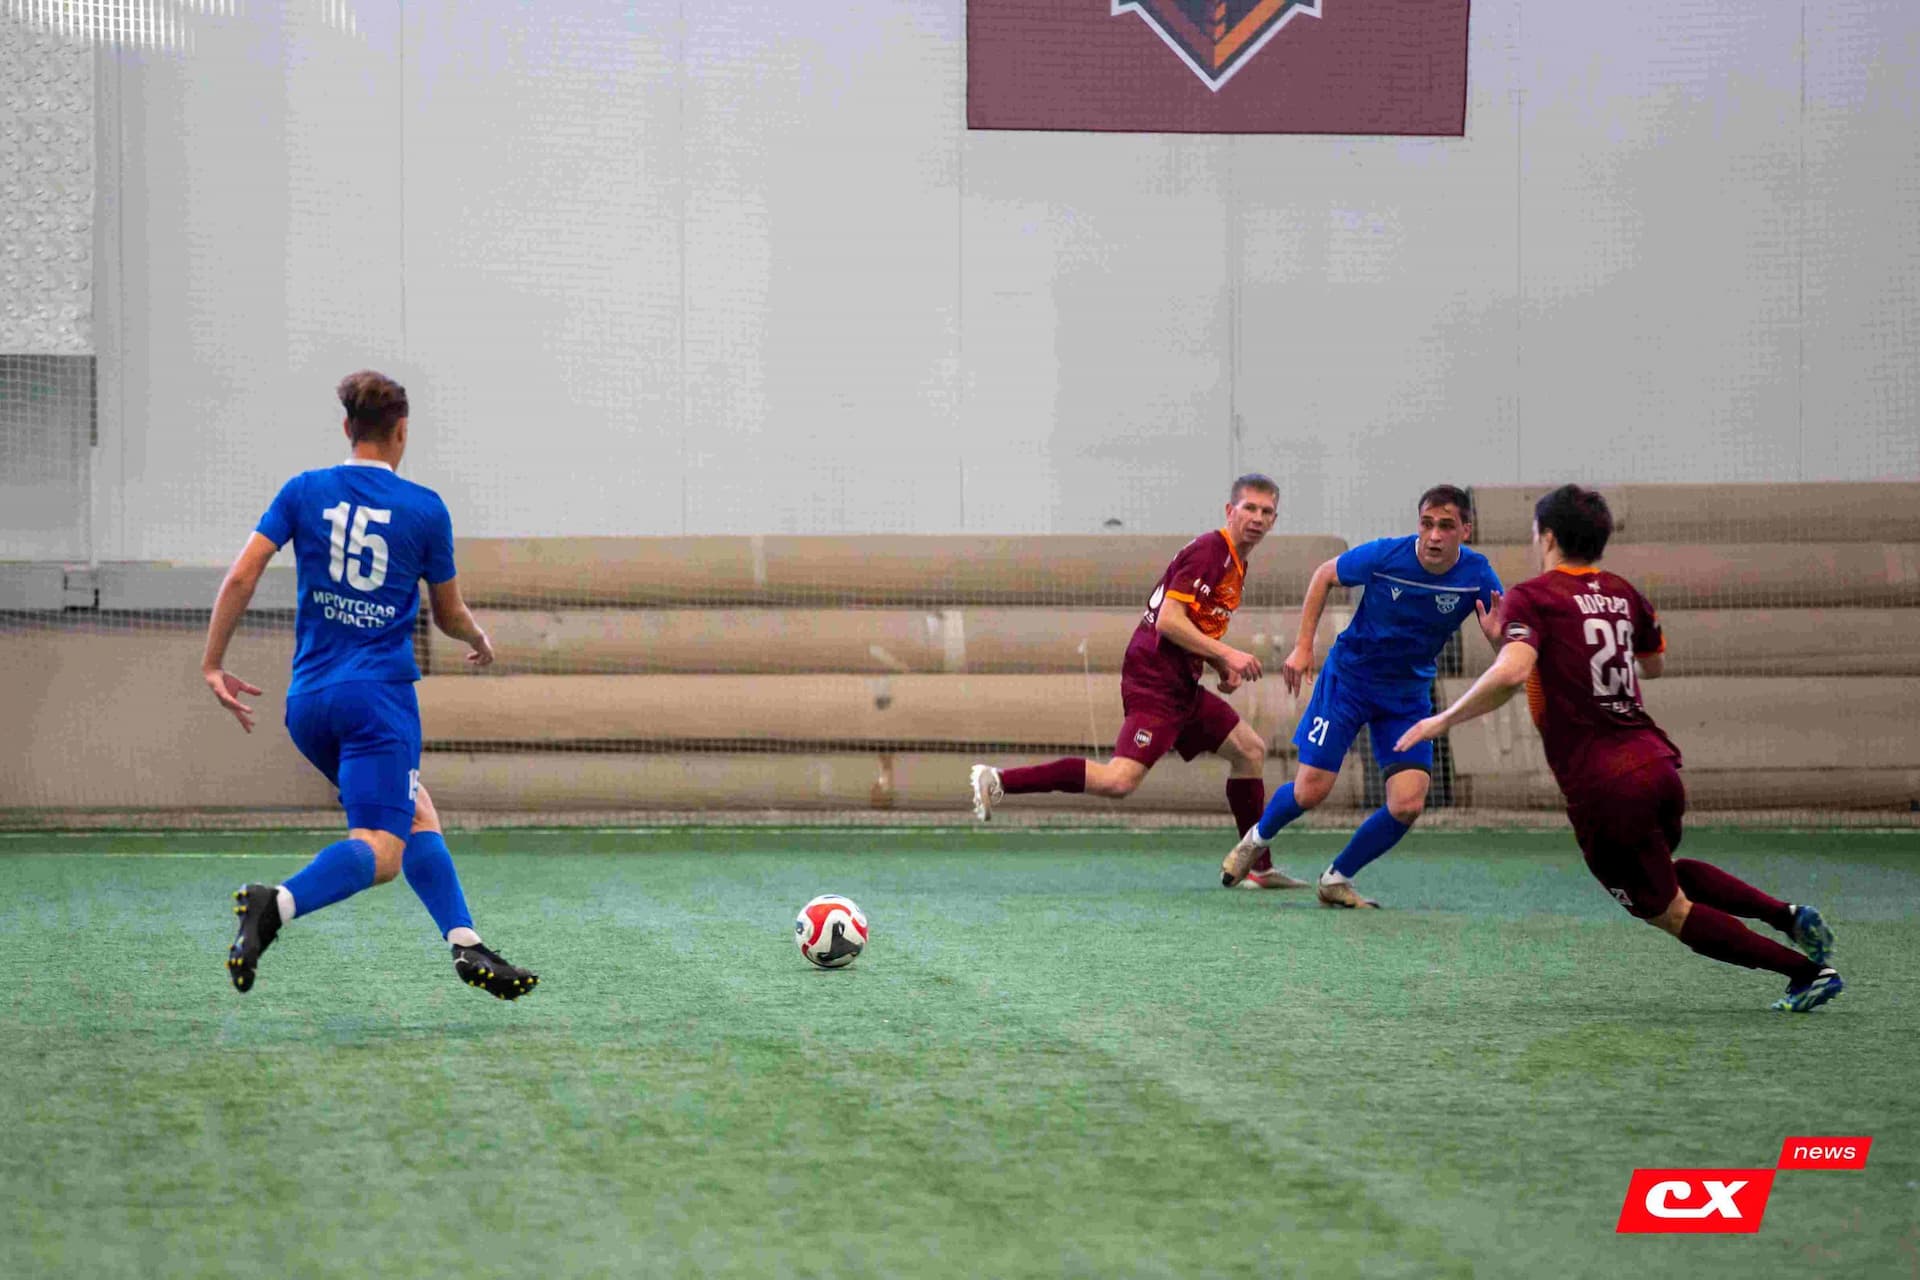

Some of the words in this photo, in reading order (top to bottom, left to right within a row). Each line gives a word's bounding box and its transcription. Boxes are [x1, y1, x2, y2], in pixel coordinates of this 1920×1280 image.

[322, 501, 392, 592] 15
[324, 605, 386, 629] ОЛАСТЬ
[1583, 618, 1636, 697] 23
[1308, 716, 1330, 746] 21
